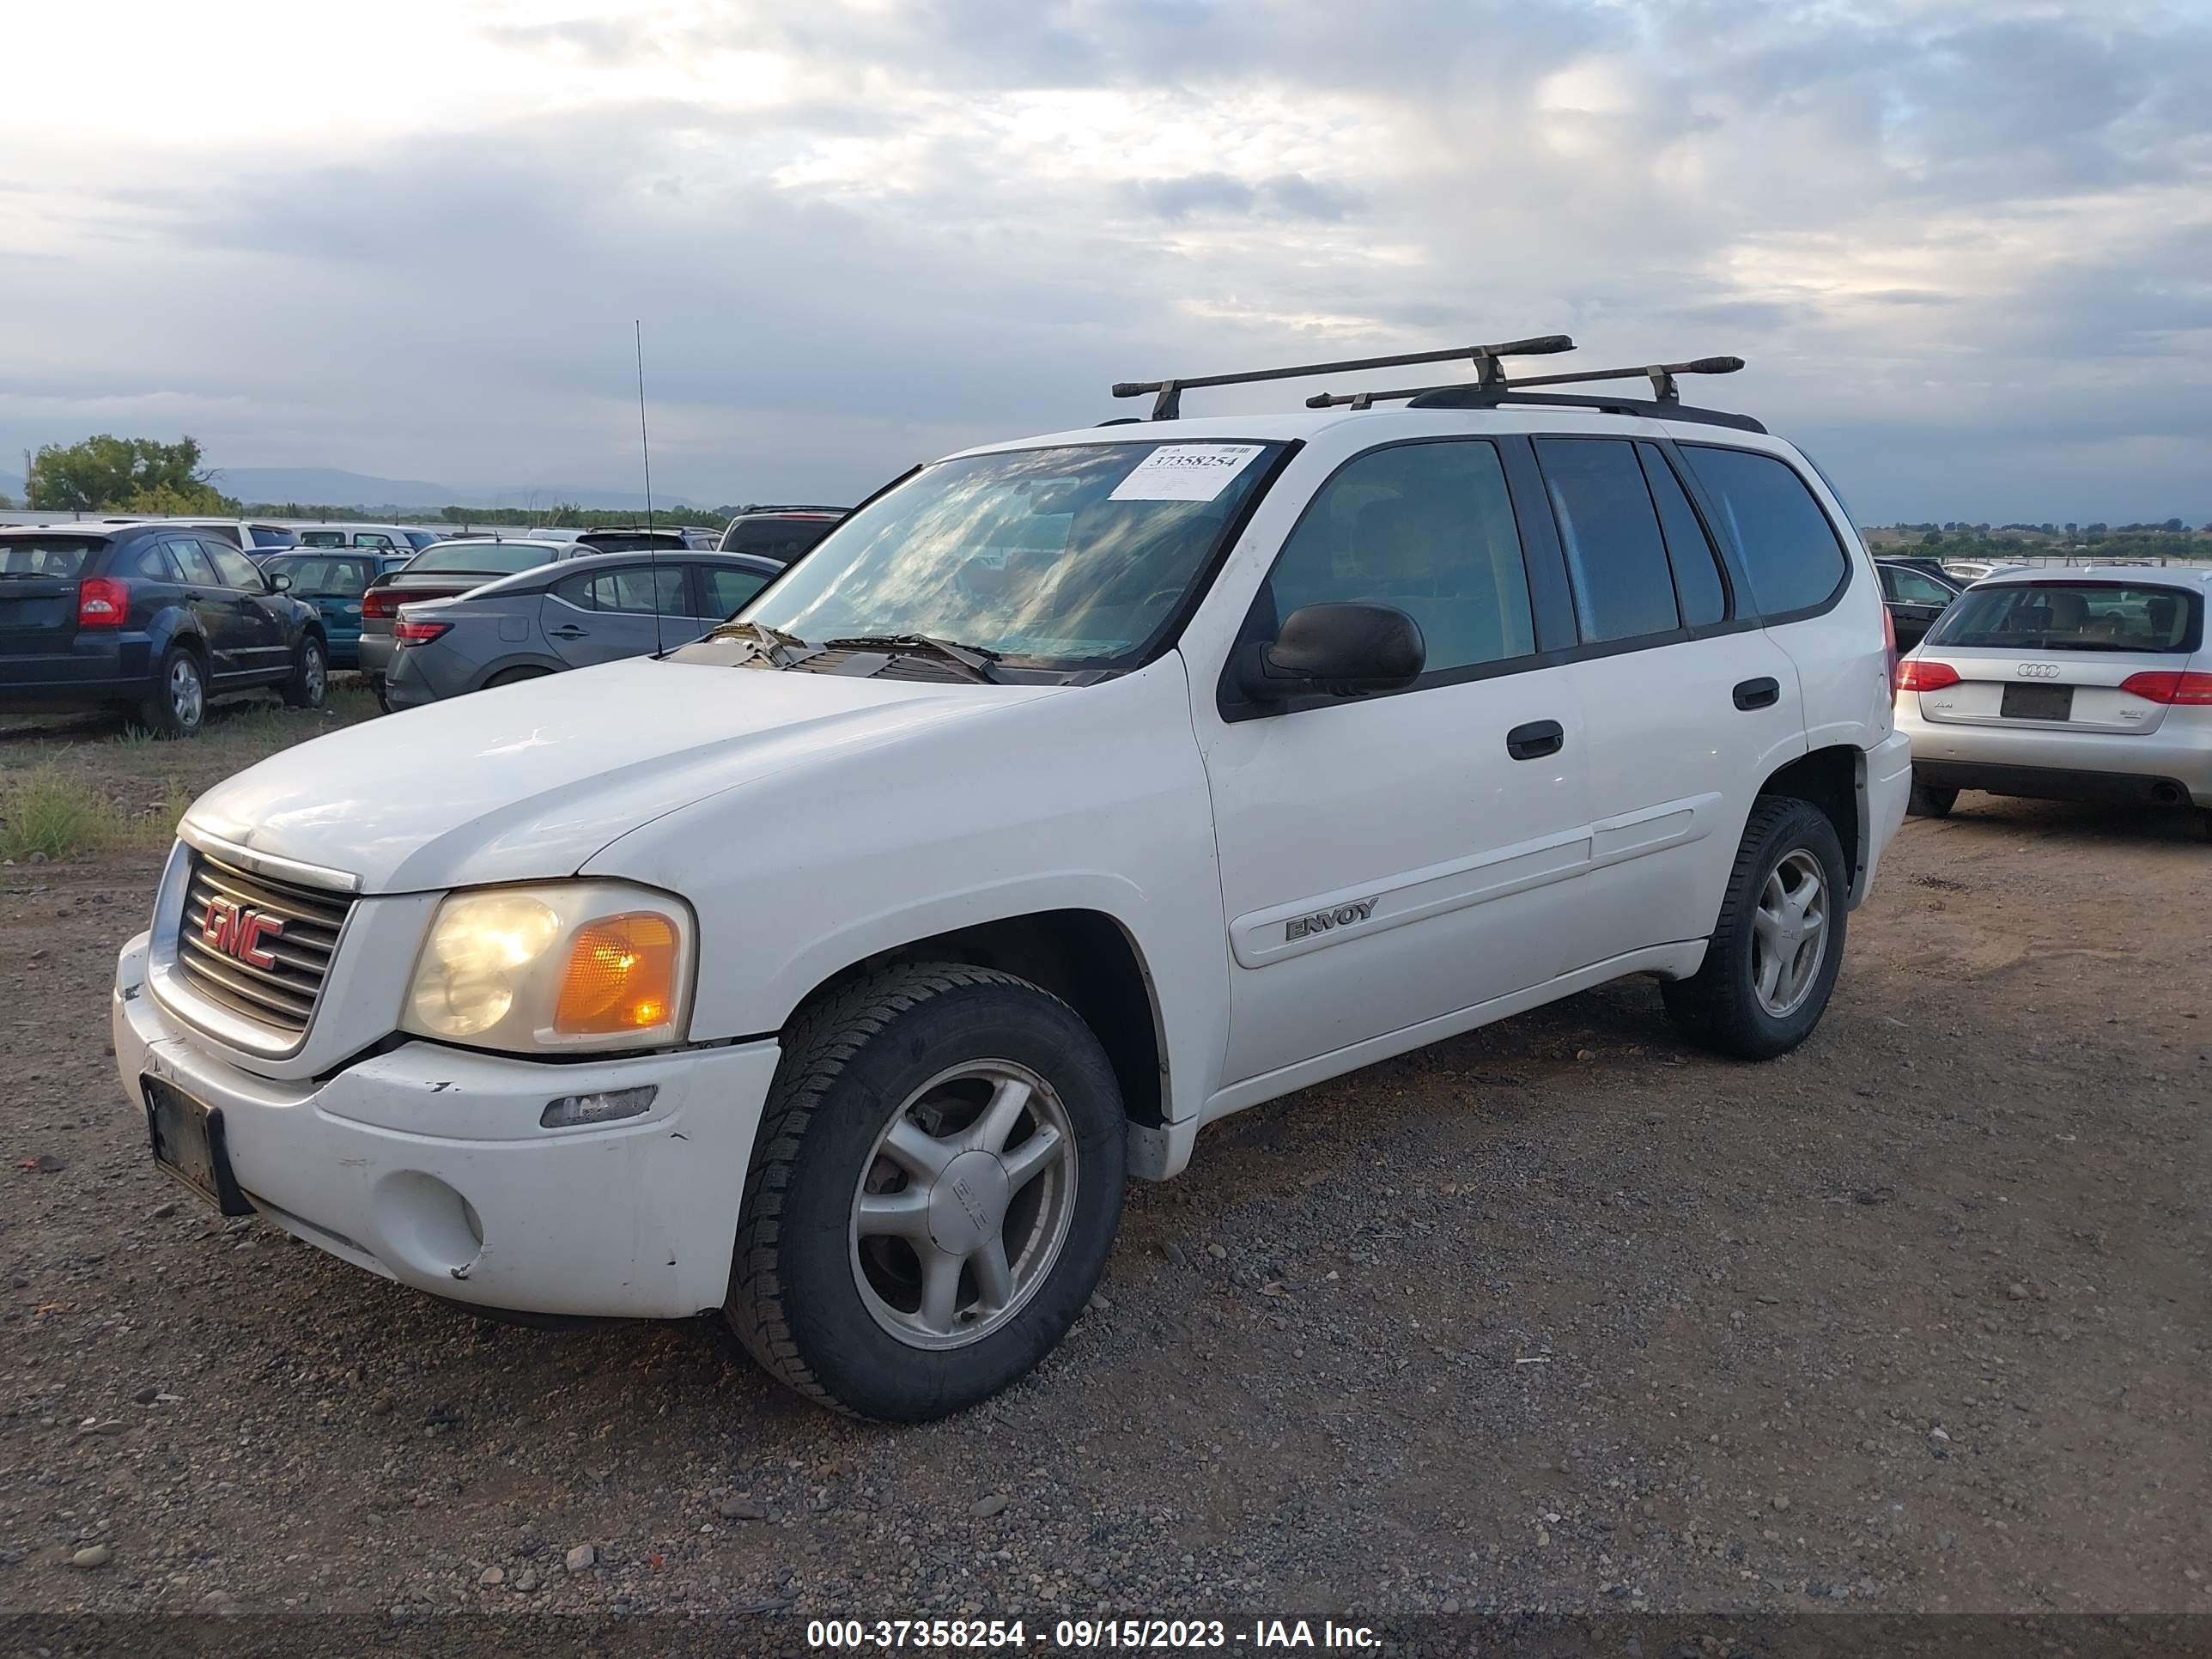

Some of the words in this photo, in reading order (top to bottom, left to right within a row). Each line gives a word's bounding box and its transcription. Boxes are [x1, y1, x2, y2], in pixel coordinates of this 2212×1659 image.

[1149, 455, 1239, 467] 37358254
[203, 895, 285, 971] GMC
[1285, 896, 1380, 942] ENVOY
